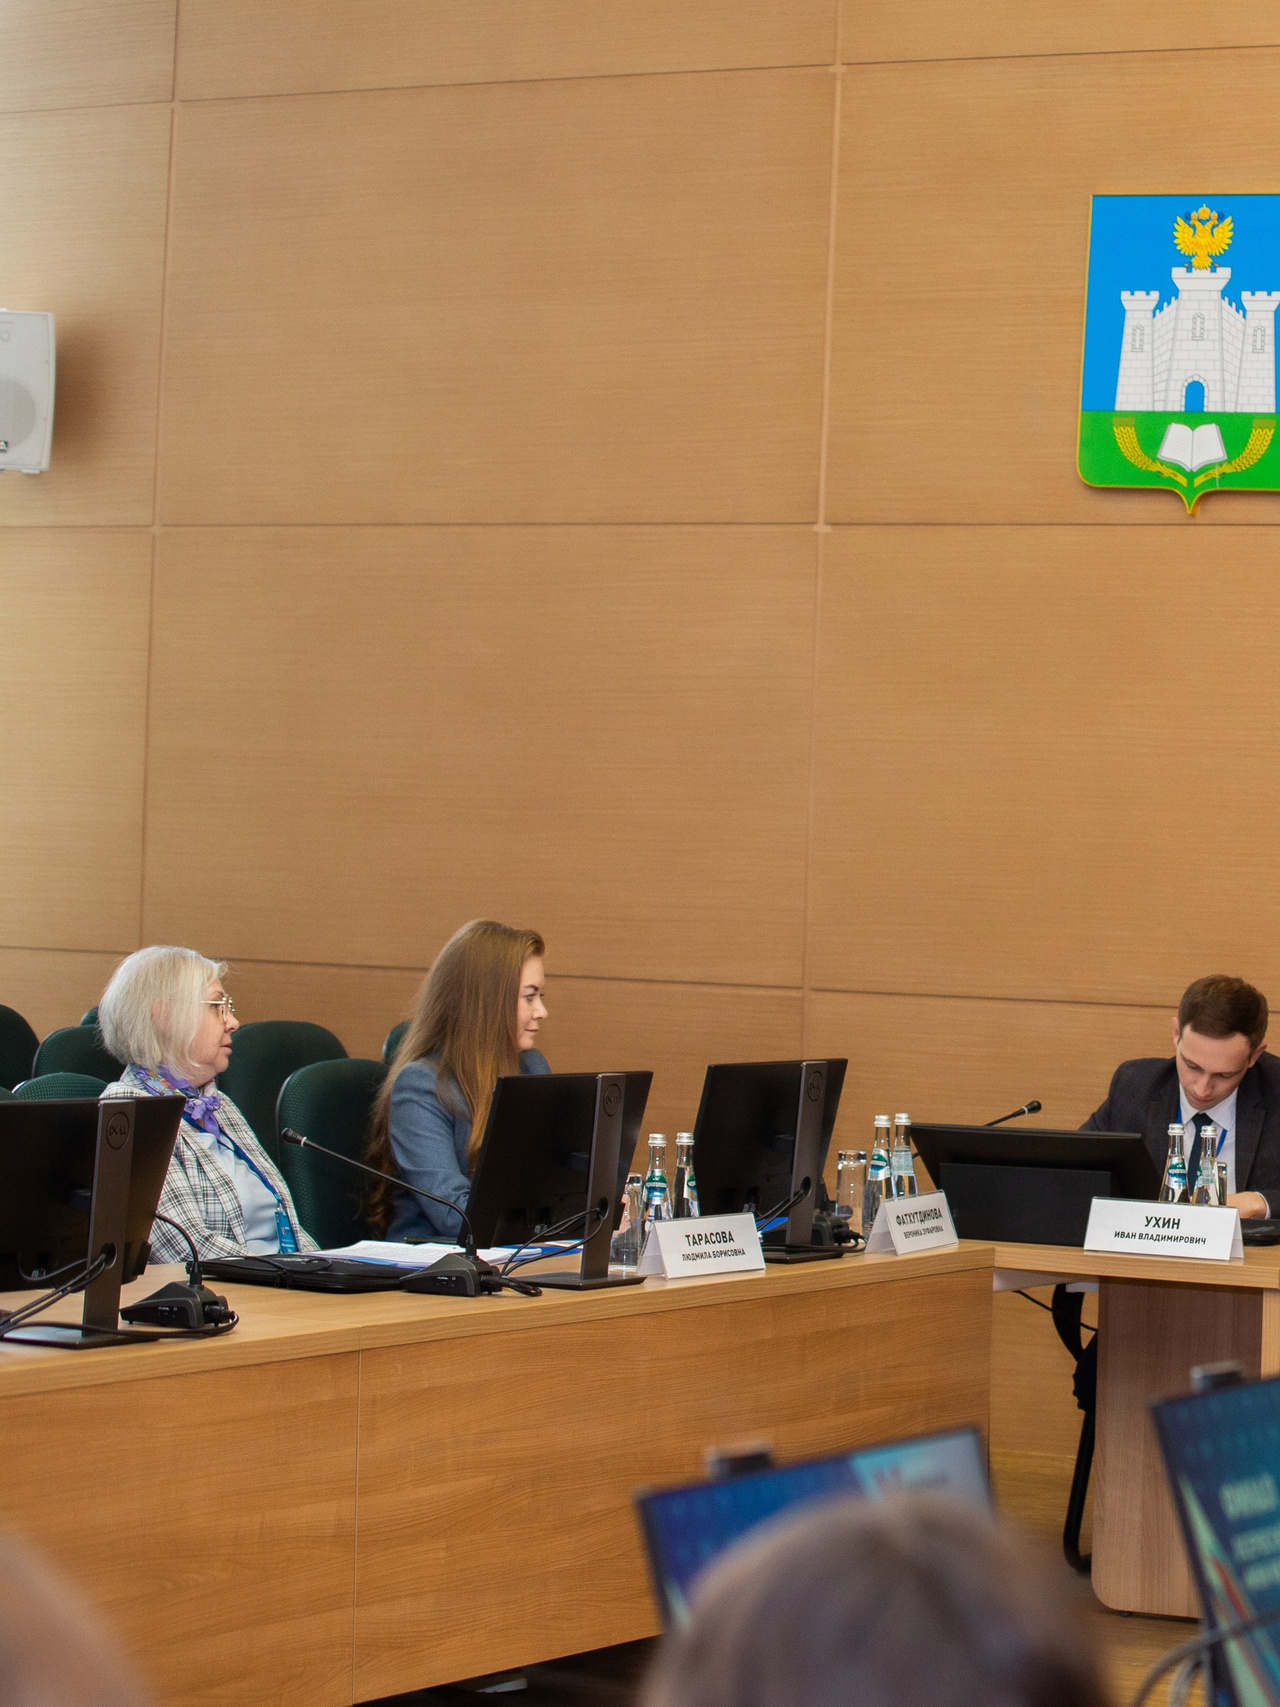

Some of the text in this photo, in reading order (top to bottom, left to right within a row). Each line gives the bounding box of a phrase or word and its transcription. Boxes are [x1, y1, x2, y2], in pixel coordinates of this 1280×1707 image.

[896, 1208, 943, 1226] ФАТХУТДИНОВА
[1144, 1216, 1181, 1229] УХИН
[685, 1231, 735, 1246] ТАРАСОВА
[1114, 1231, 1206, 1244] ИВАН ВЛАДИМИРОВИЧ
[682, 1248, 746, 1261] ЛЮДМИЛА БОРИСОВНА
